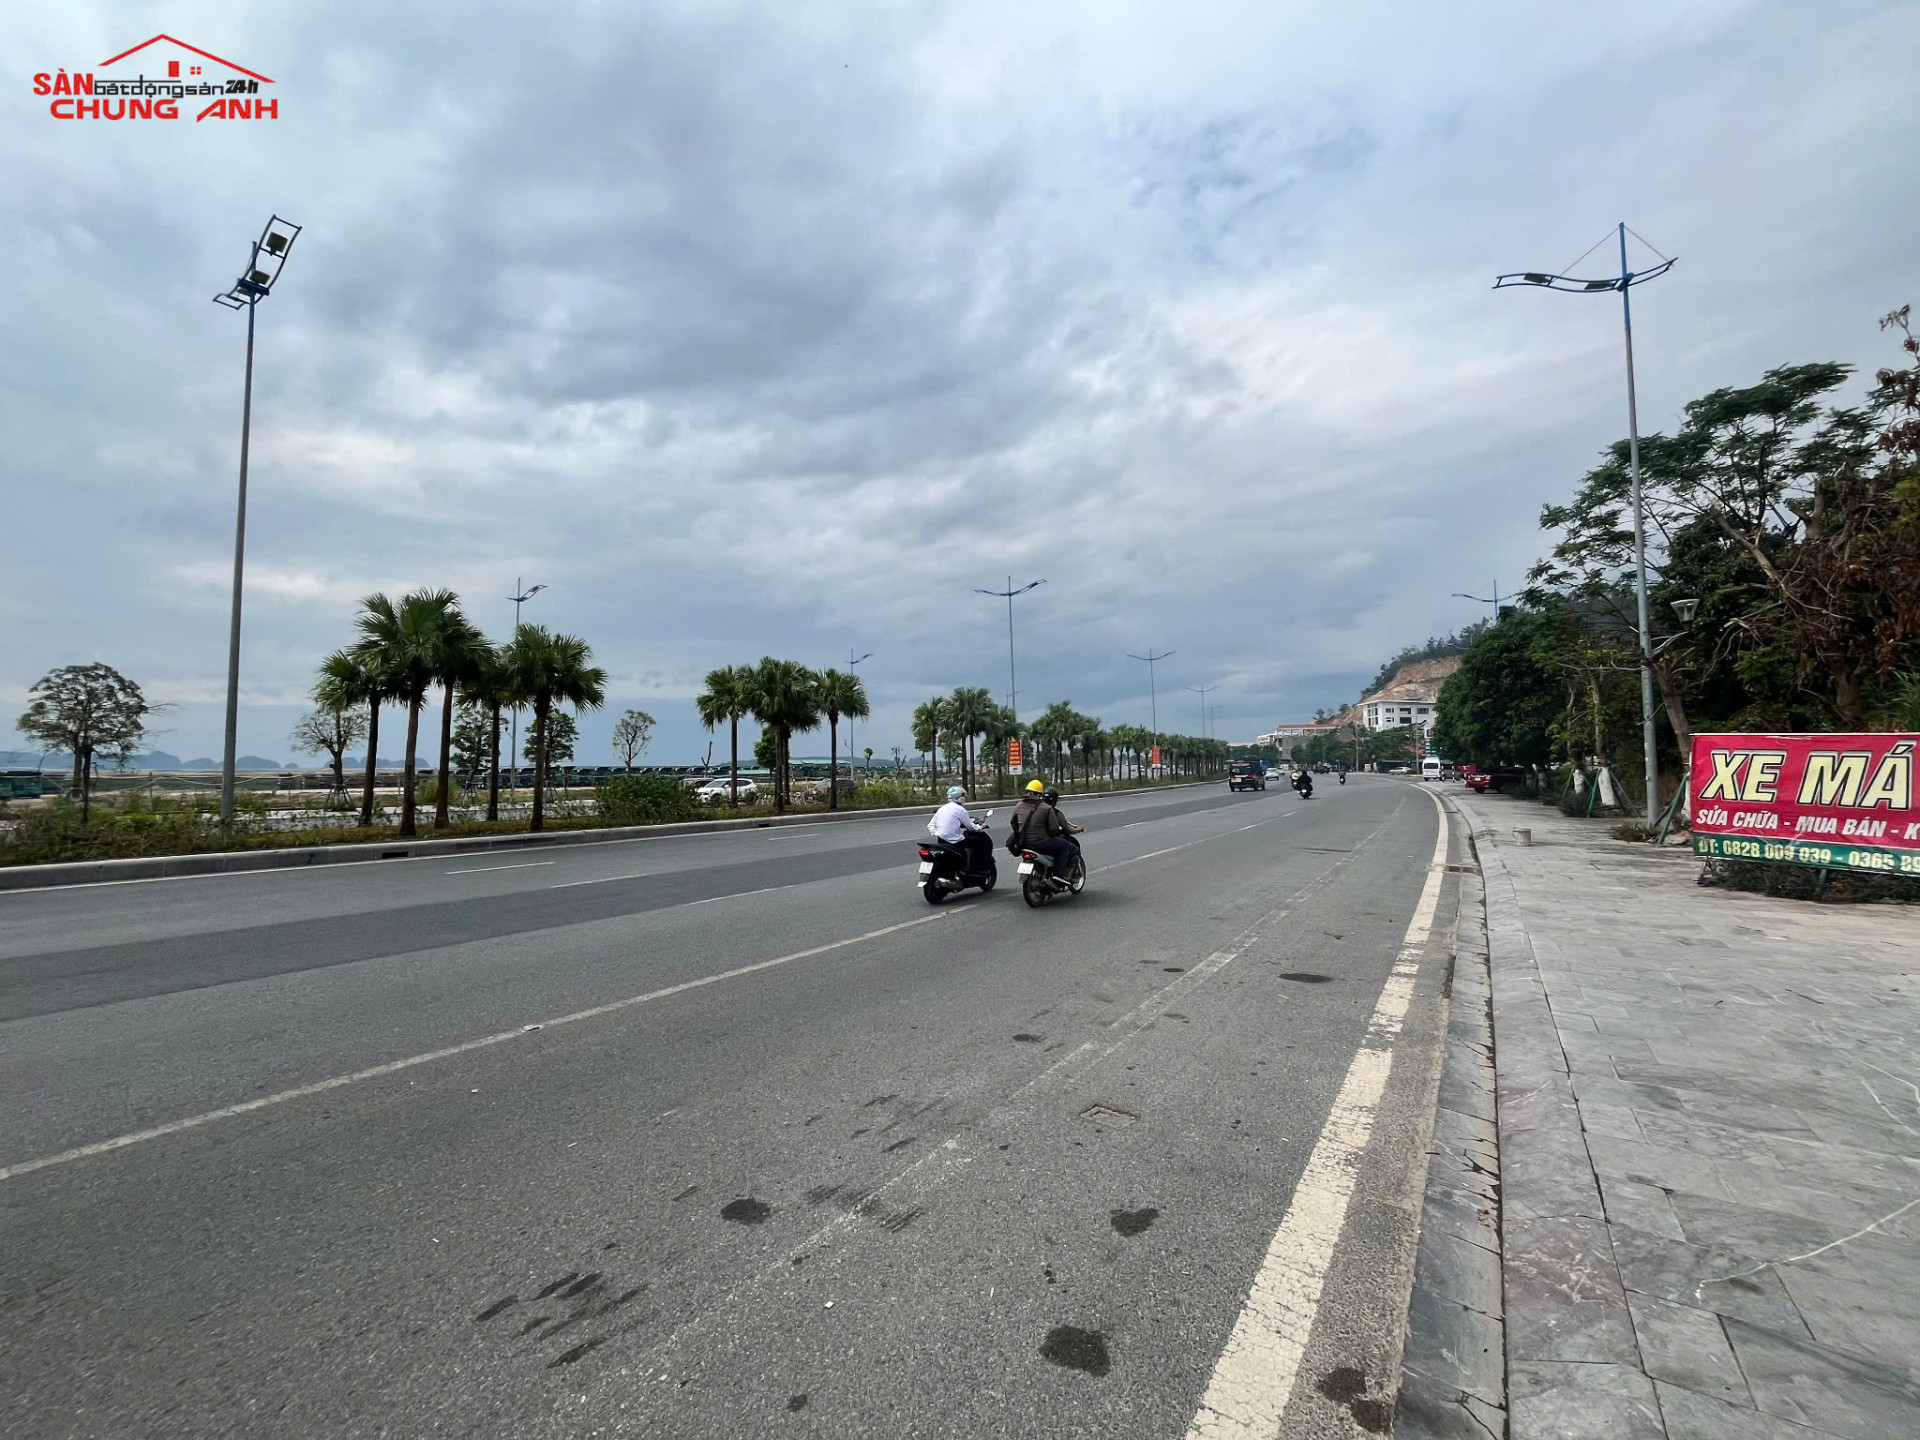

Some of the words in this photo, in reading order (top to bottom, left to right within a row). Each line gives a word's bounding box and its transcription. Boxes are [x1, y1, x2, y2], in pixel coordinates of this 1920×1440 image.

[1698, 749, 1787, 803] XE
[1796, 739, 1917, 811] MÁ
[1696, 805, 1728, 826] SỬA
[1732, 809, 1779, 830] CHỮA
[1795, 816, 1837, 834] MUA
[1842, 817, 1887, 838] BÁN
[1722, 839, 1761, 858] 0828
[1848, 850, 1895, 870] 0365
